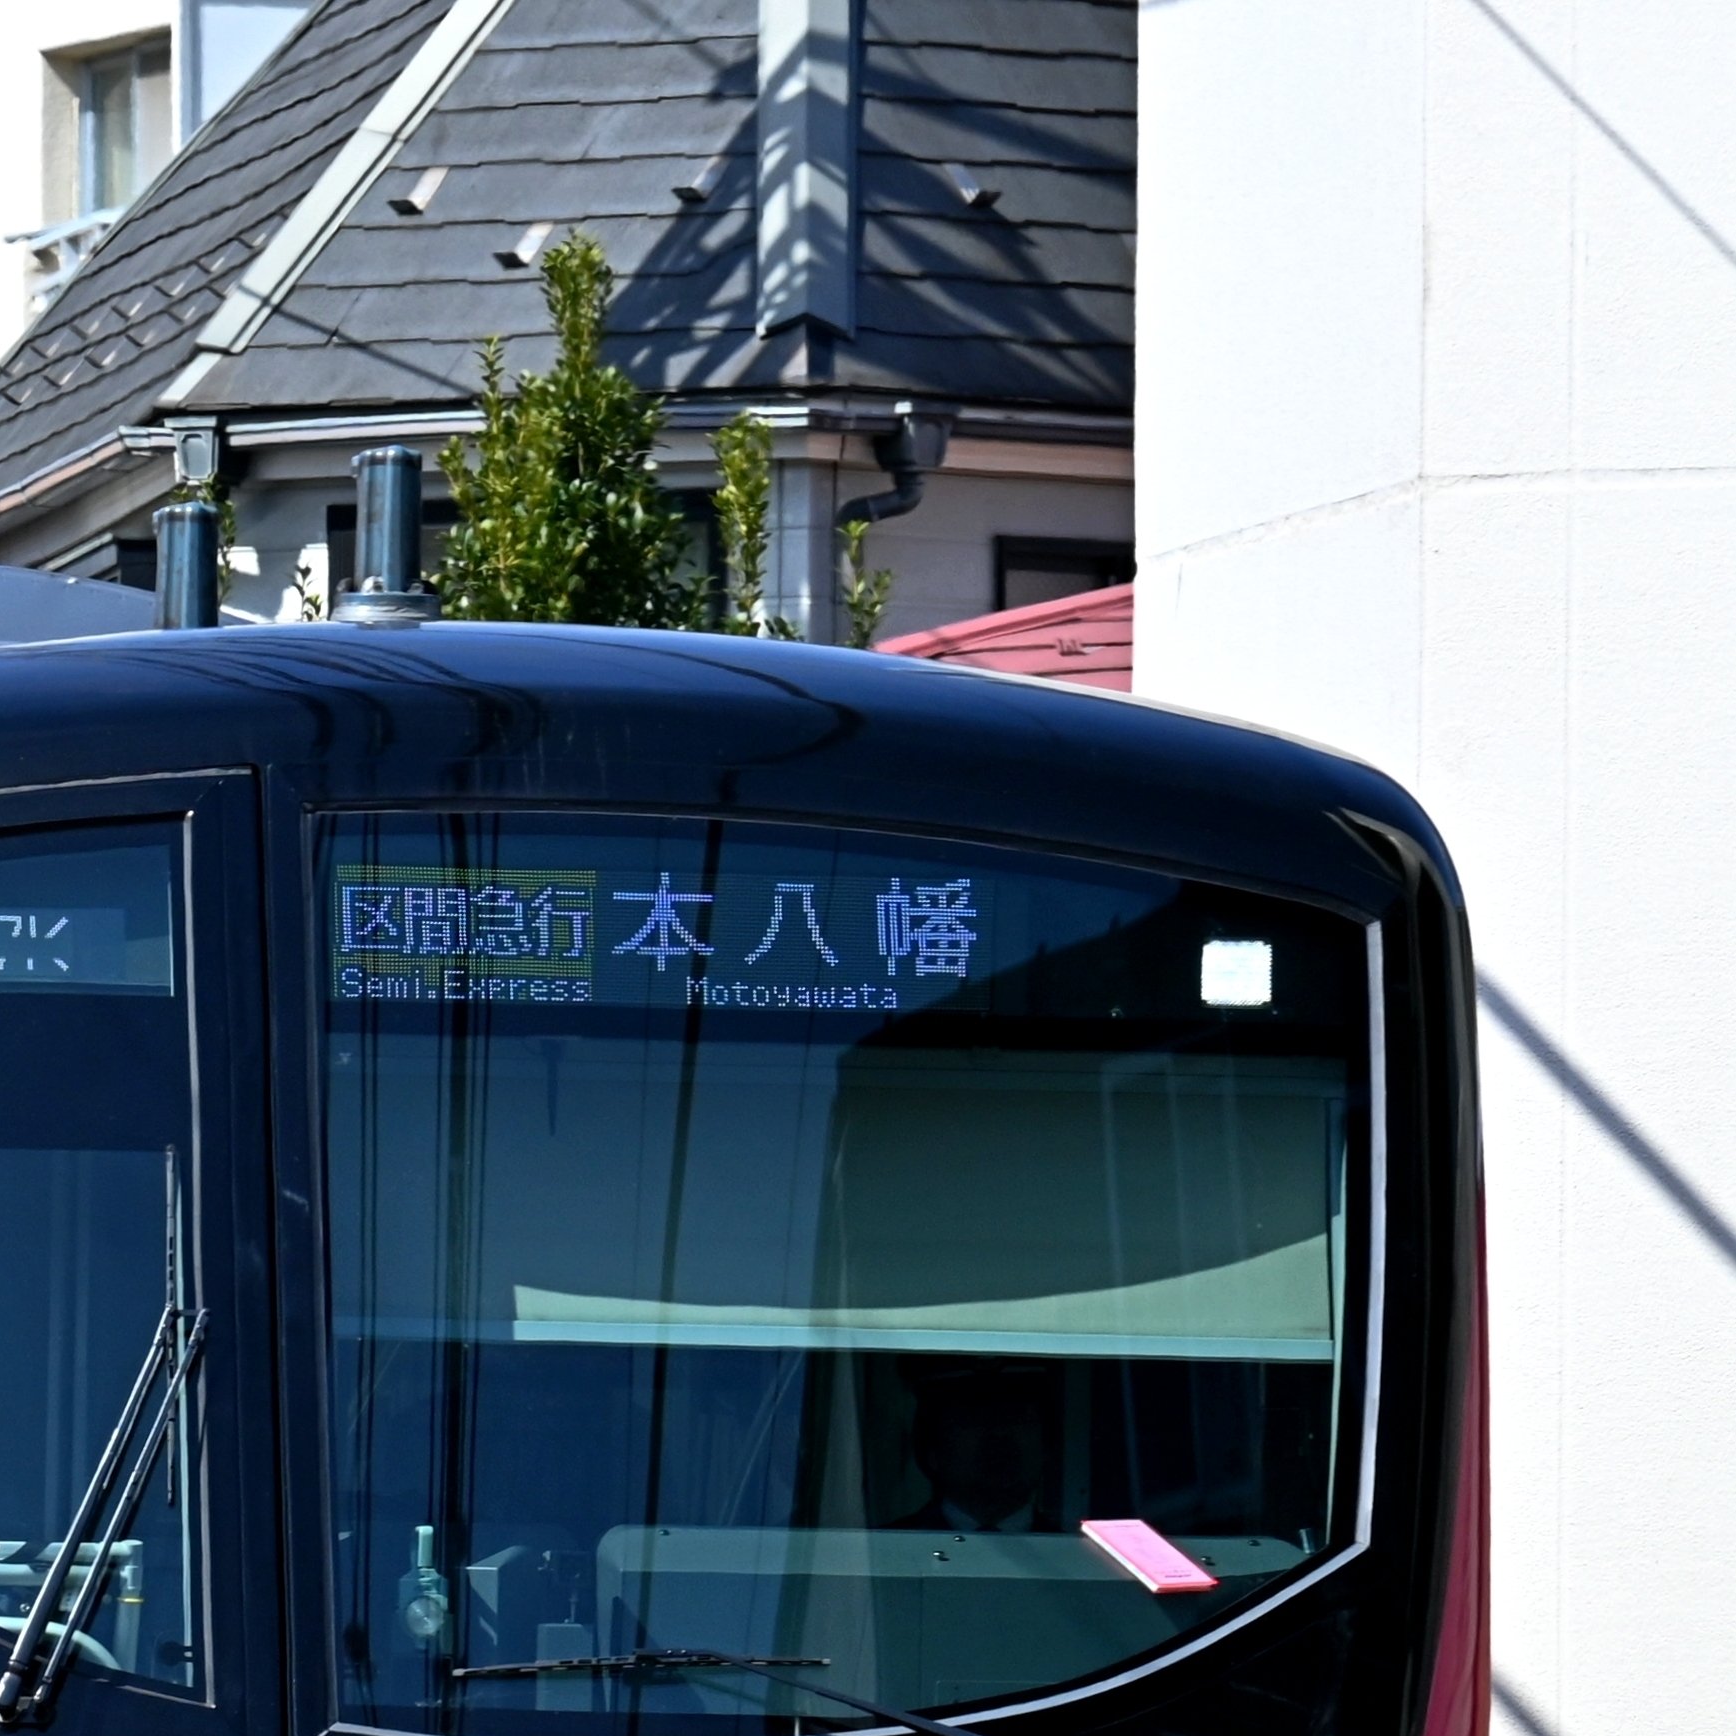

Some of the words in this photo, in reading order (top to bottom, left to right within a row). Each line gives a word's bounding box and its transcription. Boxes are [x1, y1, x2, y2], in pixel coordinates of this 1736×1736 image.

[340, 884, 589, 956] 区間急行
[611, 872, 977, 977] 本八幡
[685, 975, 898, 1010] Motoyawata
